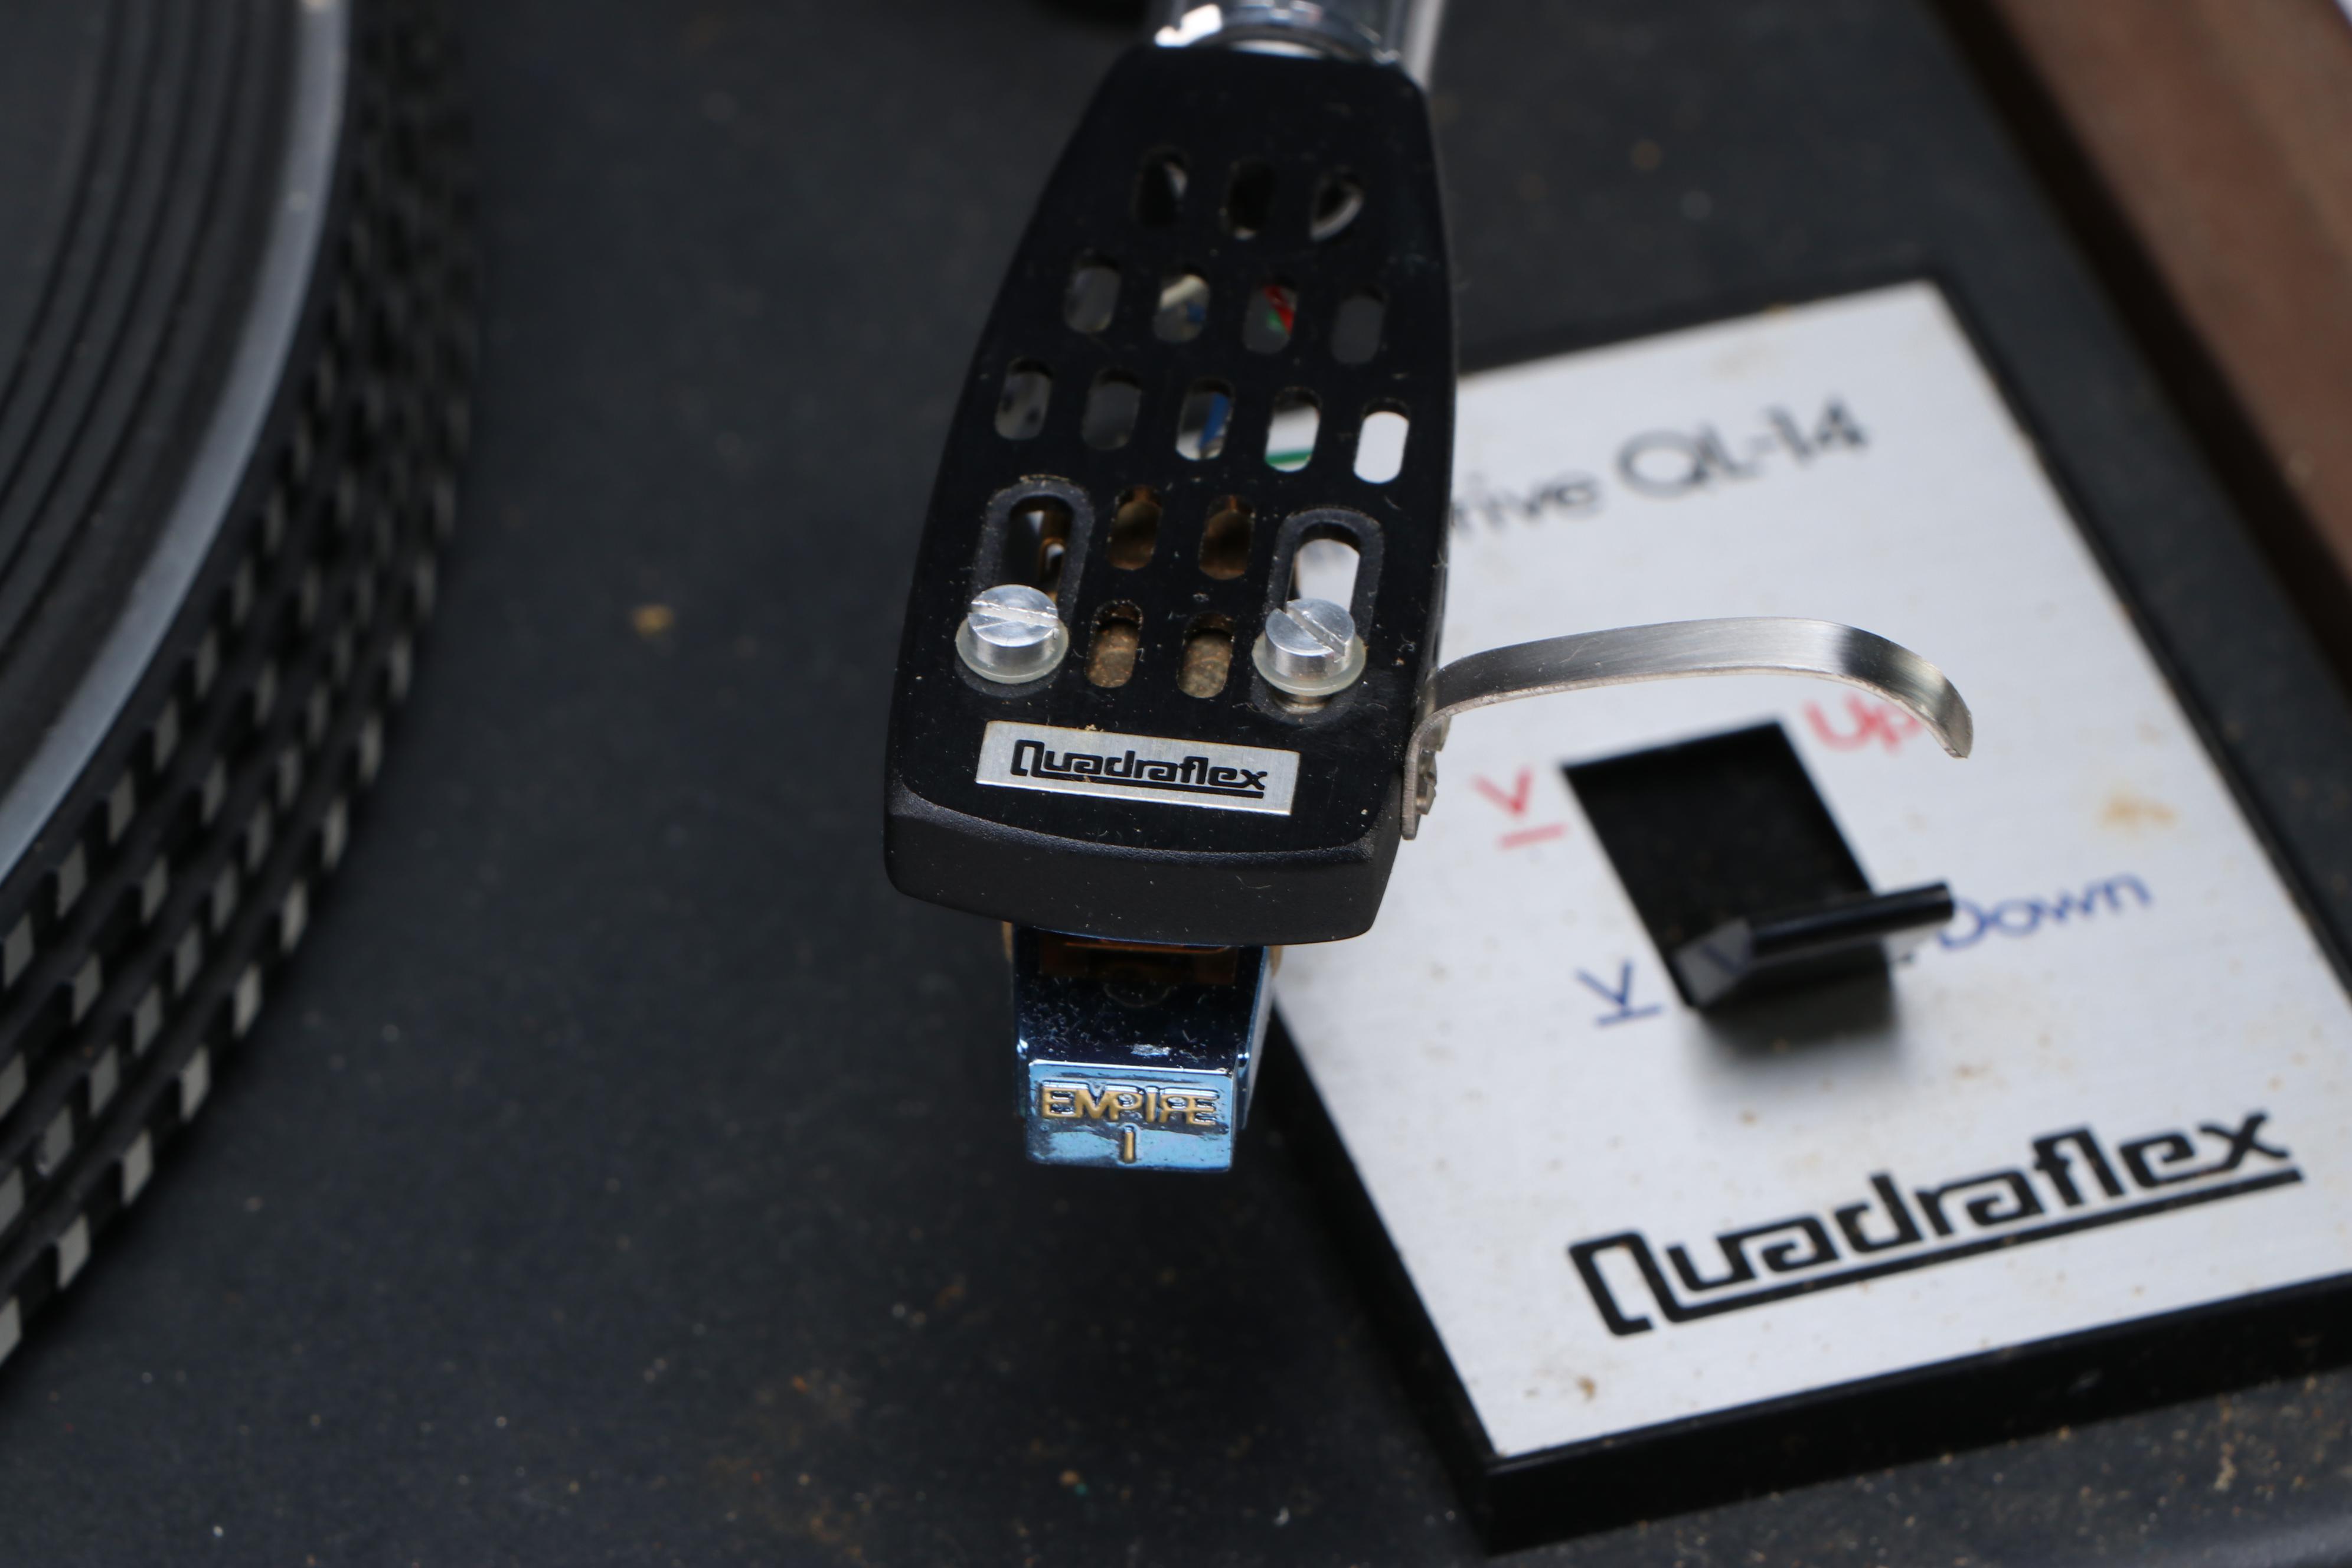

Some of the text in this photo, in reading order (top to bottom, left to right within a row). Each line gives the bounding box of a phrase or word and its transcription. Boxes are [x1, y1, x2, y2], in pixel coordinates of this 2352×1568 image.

[1615, 393, 1870, 502] QL-14
[1802, 692, 1923, 756] Up
[1010, 739, 1268, 799] Quadraflex
[1041, 1080, 1221, 1125] EMPIRE
[1567, 1112, 2305, 1337] Quadraflex
